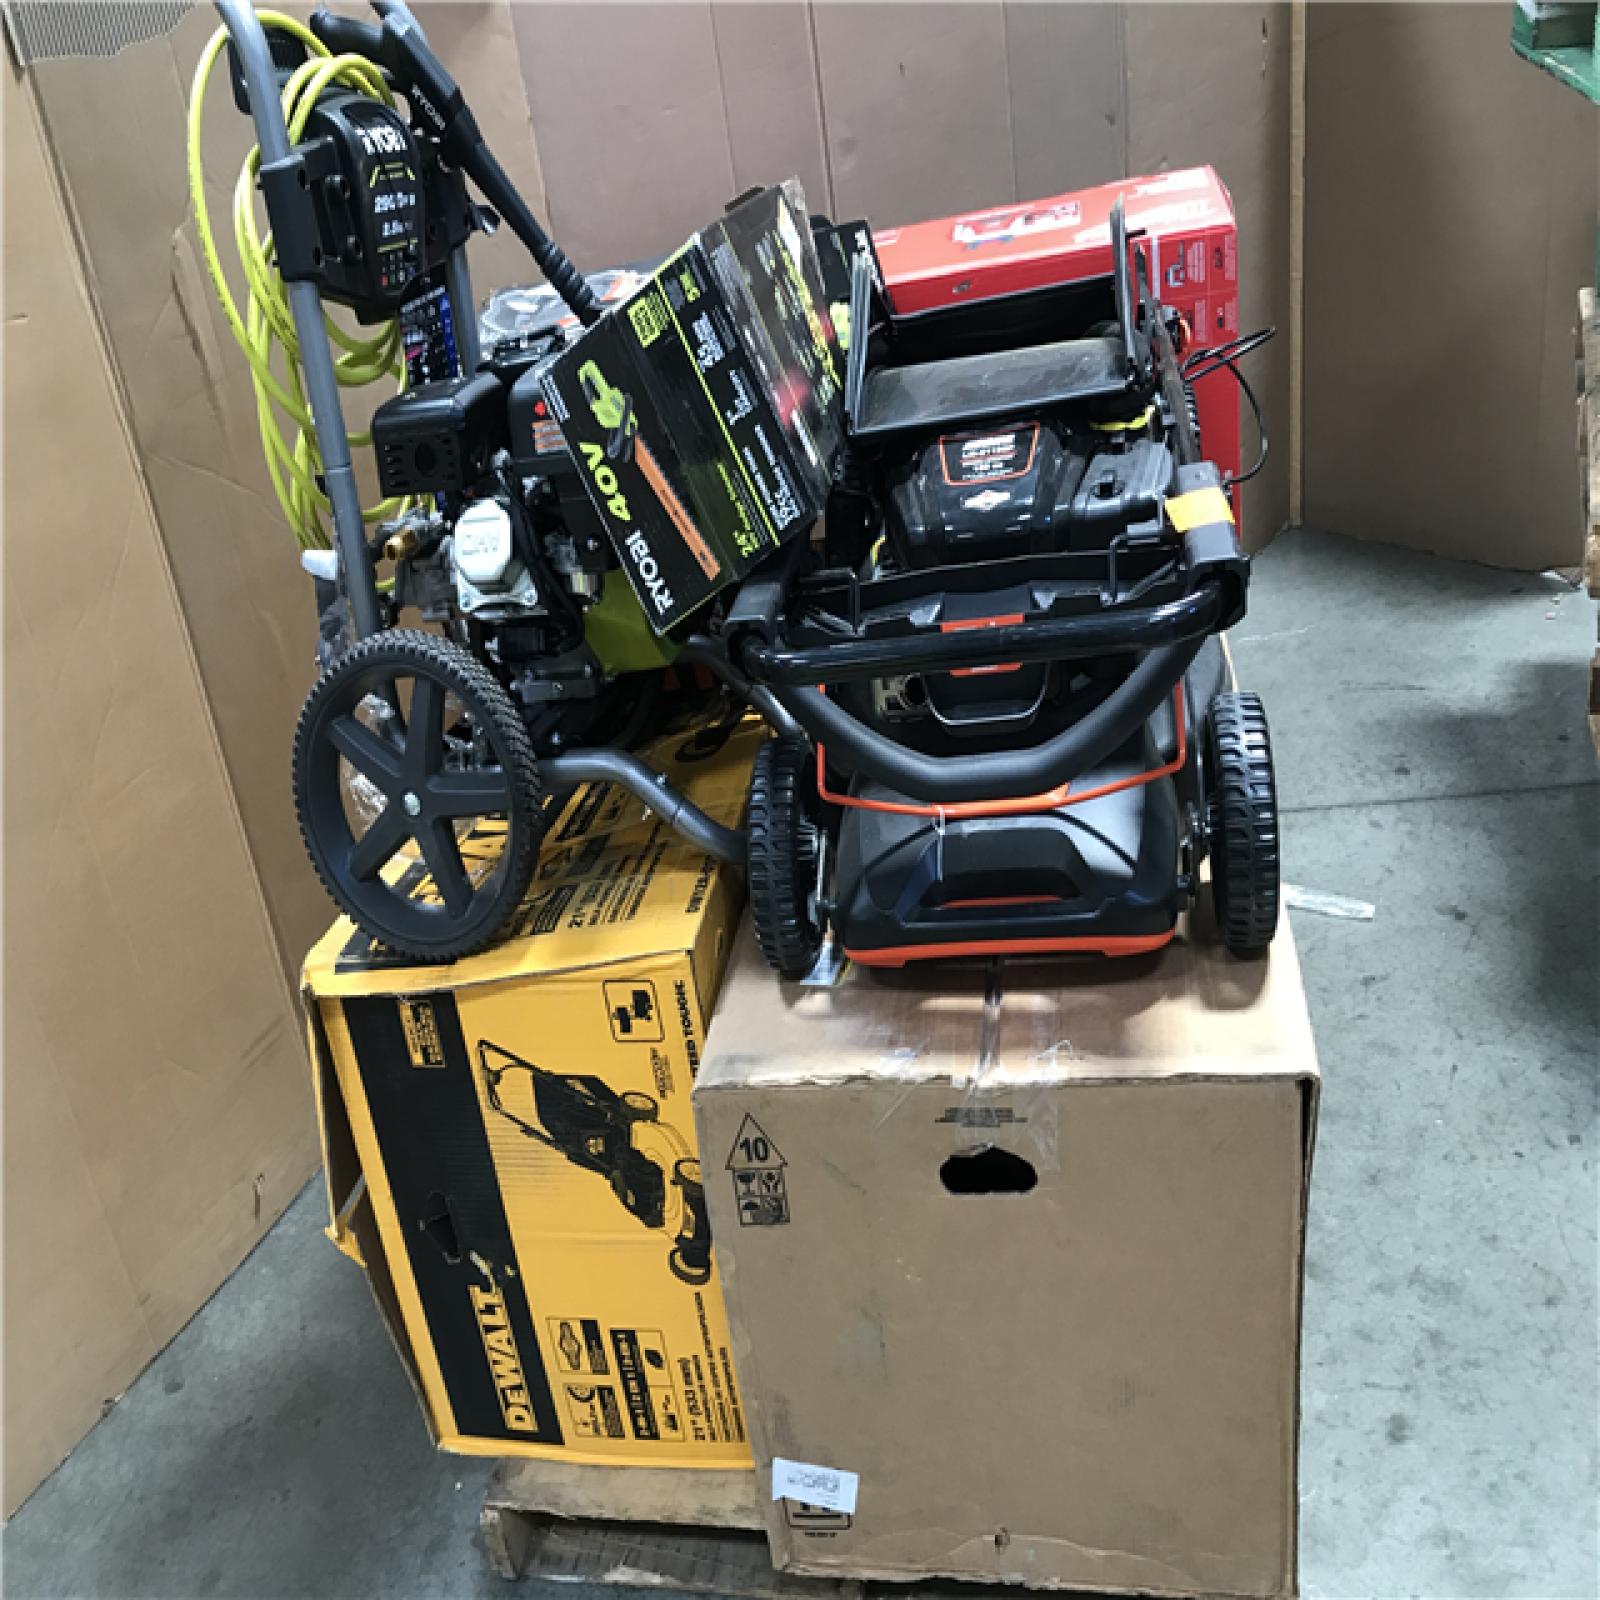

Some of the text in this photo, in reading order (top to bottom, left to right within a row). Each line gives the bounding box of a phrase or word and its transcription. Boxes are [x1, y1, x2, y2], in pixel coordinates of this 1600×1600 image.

[578, 441, 675, 616] RYOBI 40V
[739, 1137, 768, 1163] 10
[469, 1284, 539, 1433] DEWALT
